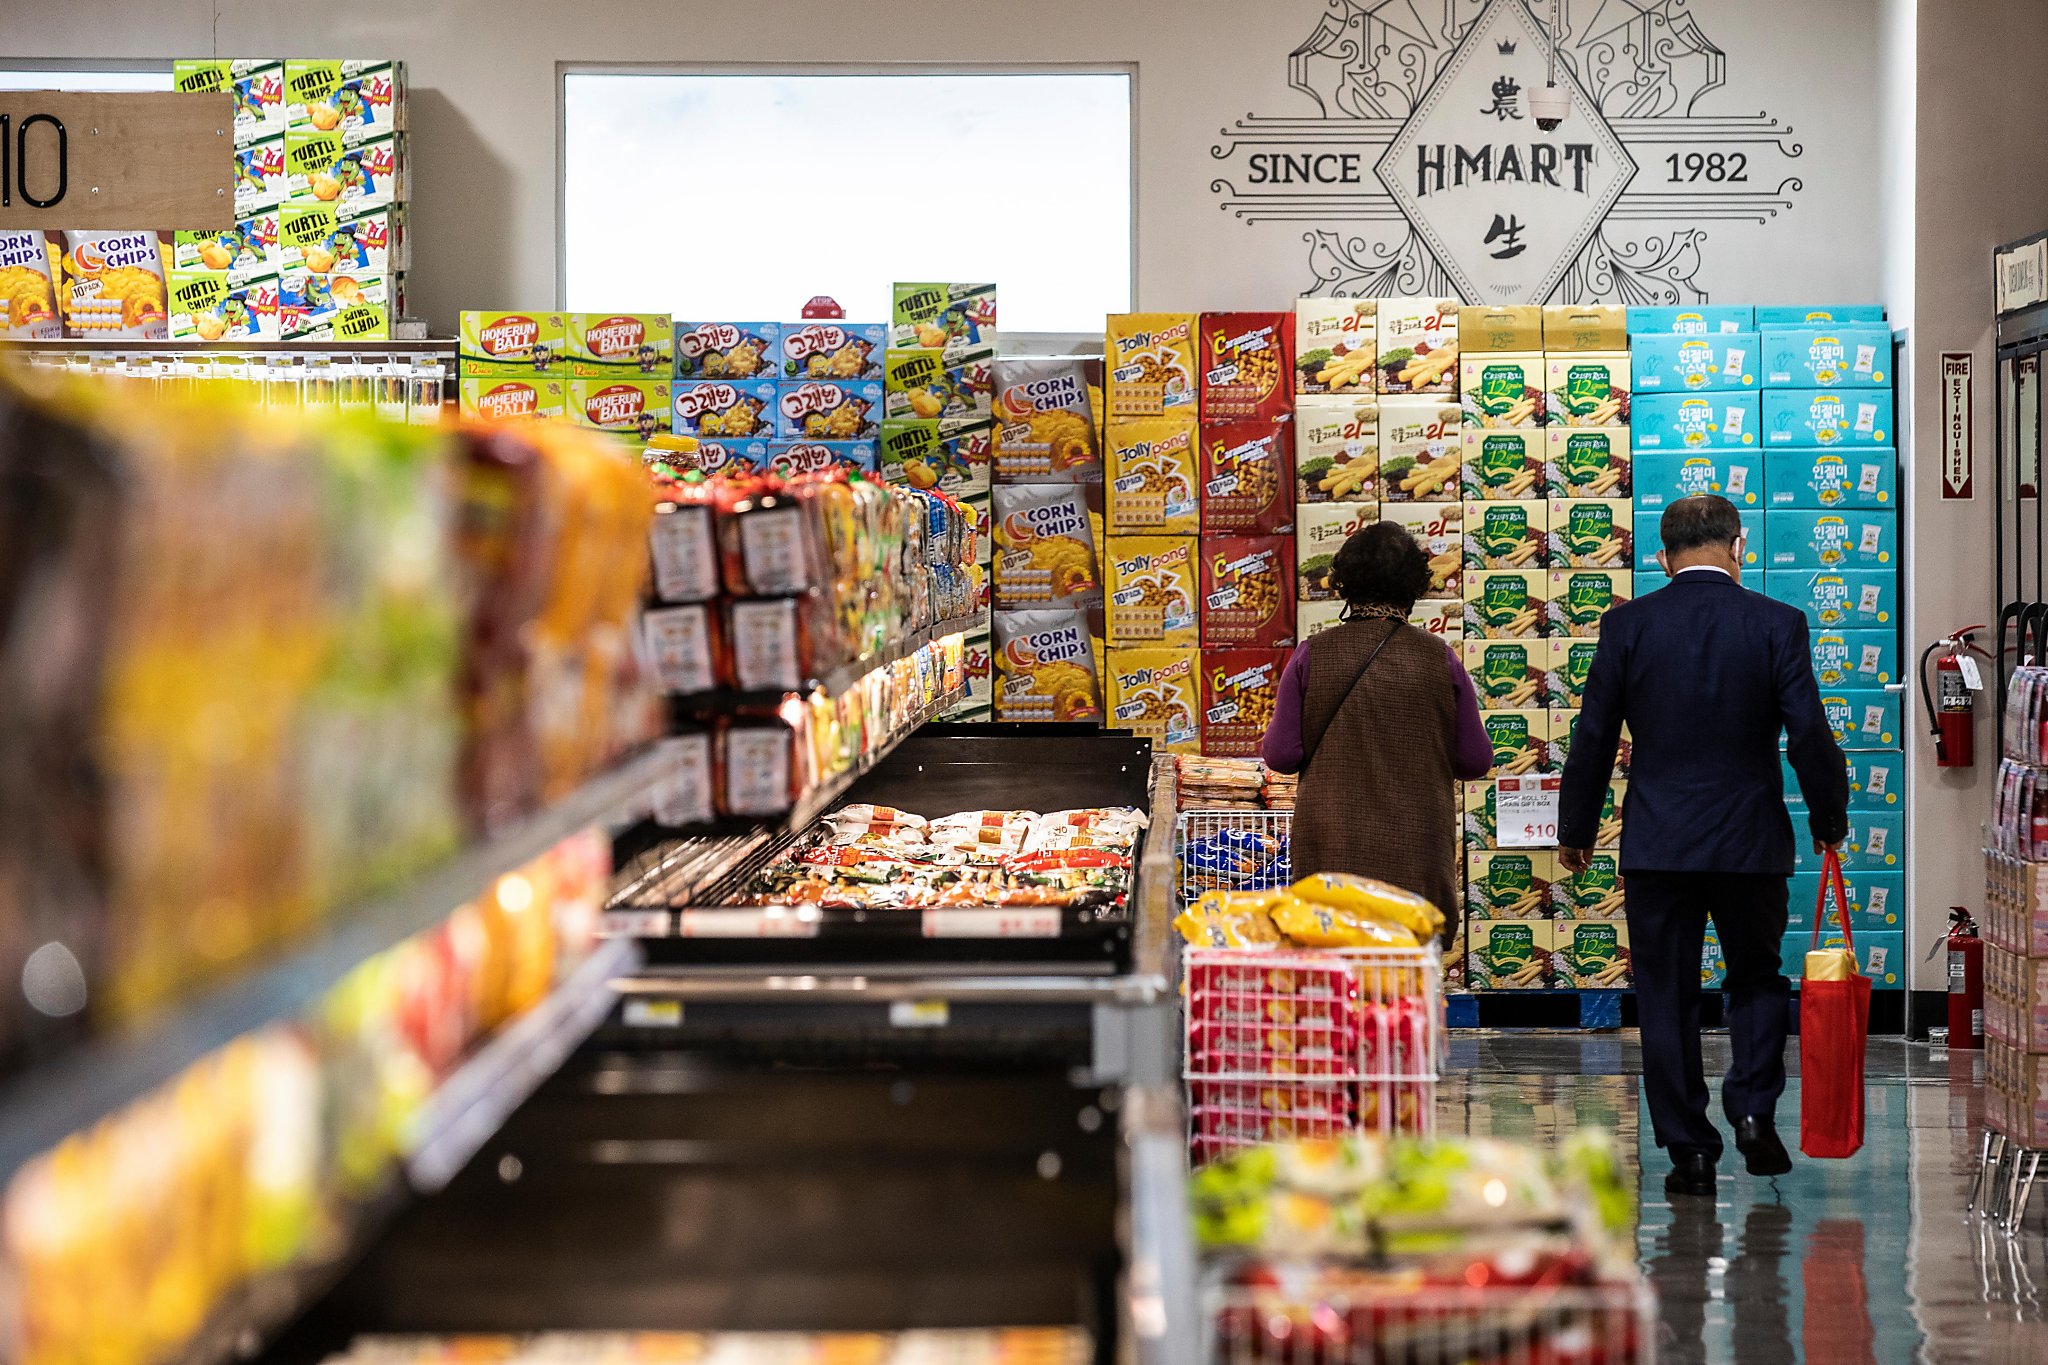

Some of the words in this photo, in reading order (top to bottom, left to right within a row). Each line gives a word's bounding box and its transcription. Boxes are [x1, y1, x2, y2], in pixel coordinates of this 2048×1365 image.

[290, 69, 335, 92] TURTLE
[302, 84, 331, 100] CHIPS
[1480, 76, 1523, 120] 農
[291, 140, 336, 163] TURTLE
[0, 112, 68, 209] 10
[303, 155, 332, 171] CHIPS
[1666, 153, 1748, 182] 1982
[1249, 154, 1361, 184] SINCE
[1417, 144, 1594, 198] HMART
[284, 213, 330, 236] TURTLE
[0, 235, 33, 252] ORN
[98, 235, 146, 253] CORN
[297, 228, 326, 244] CHIPS
[1484, 214, 1527, 259] 生
[0, 249, 42, 268] HIPS
[106, 249, 156, 268] CHIPS
[73, 286, 86, 298] 10
[175, 279, 221, 302] TURTLE
[187, 295, 217, 311] CHIPS
[898, 291, 942, 312] TURTLE
[909, 306, 938, 320] CHIPS
[480, 322, 537, 342] HOMERUN
[586, 323, 642, 342] HOMERUN
[1116, 332, 1151, 353] Jolly
[1151, 323, 1189, 350] pong
[494, 334, 534, 352] BALL
[600, 335, 640, 353] BALL
[684, 328, 734, 353] 고래밥
[788, 330, 839, 355] 고래밥
[1678, 349, 1713, 364] 인절미
[1809, 345, 1844, 360] 인절미
[468, 363, 478, 374] 12
[574, 364, 584, 376] 12
[891, 358, 936, 381] TURTLE
[1686, 363, 1707, 375] 스낵
[1817, 359, 1838, 371] 스낵
[1945, 362, 1969, 375] FIRE
[903, 373, 932, 389] CHIPS
[1114, 370, 1126, 382] 10
[1208, 371, 1220, 384] 10
[1027, 376, 1075, 397] CORN
[1487, 380, 1511, 396] 12
[1572, 380, 1596, 396] 12
[479, 389, 536, 408] HOMERUN
[586, 391, 642, 410] HOMERUN
[680, 388, 731, 414] 고래밥
[786, 389, 836, 414] 고래밥
[1035, 391, 1084, 411] CHIPS
[493, 402, 532, 418] BALL
[600, 403, 640, 421] BALL
[1678, 407, 1713, 422] 인절미
[1809, 404, 1844, 419] 인절미
[1686, 421, 1707, 433] 스낵
[1817, 418, 1838, 430] 스낵
[1953, 378, 1961, 484] EXTINGUISHER
[887, 429, 932, 451] TURTLE
[1002, 430, 1014, 443] 10
[898, 443, 928, 460] CHIPS
[1116, 442, 1151, 463] Jolly
[1151, 433, 1190, 460] pong
[1572, 448, 1596, 464] 12
[1488, 450, 1512, 466] 12
[1680, 467, 1715, 482] 인절미
[1812, 465, 1847, 480] 인절미
[1115, 481, 1127, 492] 10
[1208, 482, 1220, 495] 10
[1688, 481, 1709, 493] 스낵
[1820, 479, 1841, 491] 스낵
[1028, 503, 1076, 523] CORN
[1036, 517, 1085, 537] CHIPS
[1490, 521, 1514, 537] 12
[1575, 519, 1599, 535] 12
[1813, 525, 1848, 540] 인절미
[1821, 539, 1842, 551] 스낵
[1003, 558, 1014, 570] 10
[1115, 555, 1150, 576] Jolly
[1151, 546, 1188, 573] pong
[1113, 593, 1126, 606] 10
[1490, 590, 1514, 606] 12
[1574, 588, 1598, 604] 12
[1813, 585, 1848, 600] 인절미
[1208, 595, 1221, 608] 10
[1821, 599, 1842, 611] 스낵
[1029, 628, 1077, 648] CORN
[1038, 642, 1087, 663] CHIPS
[1813, 645, 1848, 660] 인절미
[1490, 660, 1514, 676] 12
[1821, 659, 1842, 671] 스낵
[1117, 668, 1153, 690] Jolly
[1153, 660, 1190, 687] pong
[1005, 681, 1017, 694] 10
[1115, 706, 1128, 719] 10
[1208, 709, 1220, 722] 10
[1490, 730, 1514, 746] 12
[1524, 823, 1556, 841] $10
[1494, 870, 1518, 886] 12
[1578, 870, 1602, 886] 12
[1495, 940, 1519, 956] 12
[1579, 939, 1603, 955] 12
